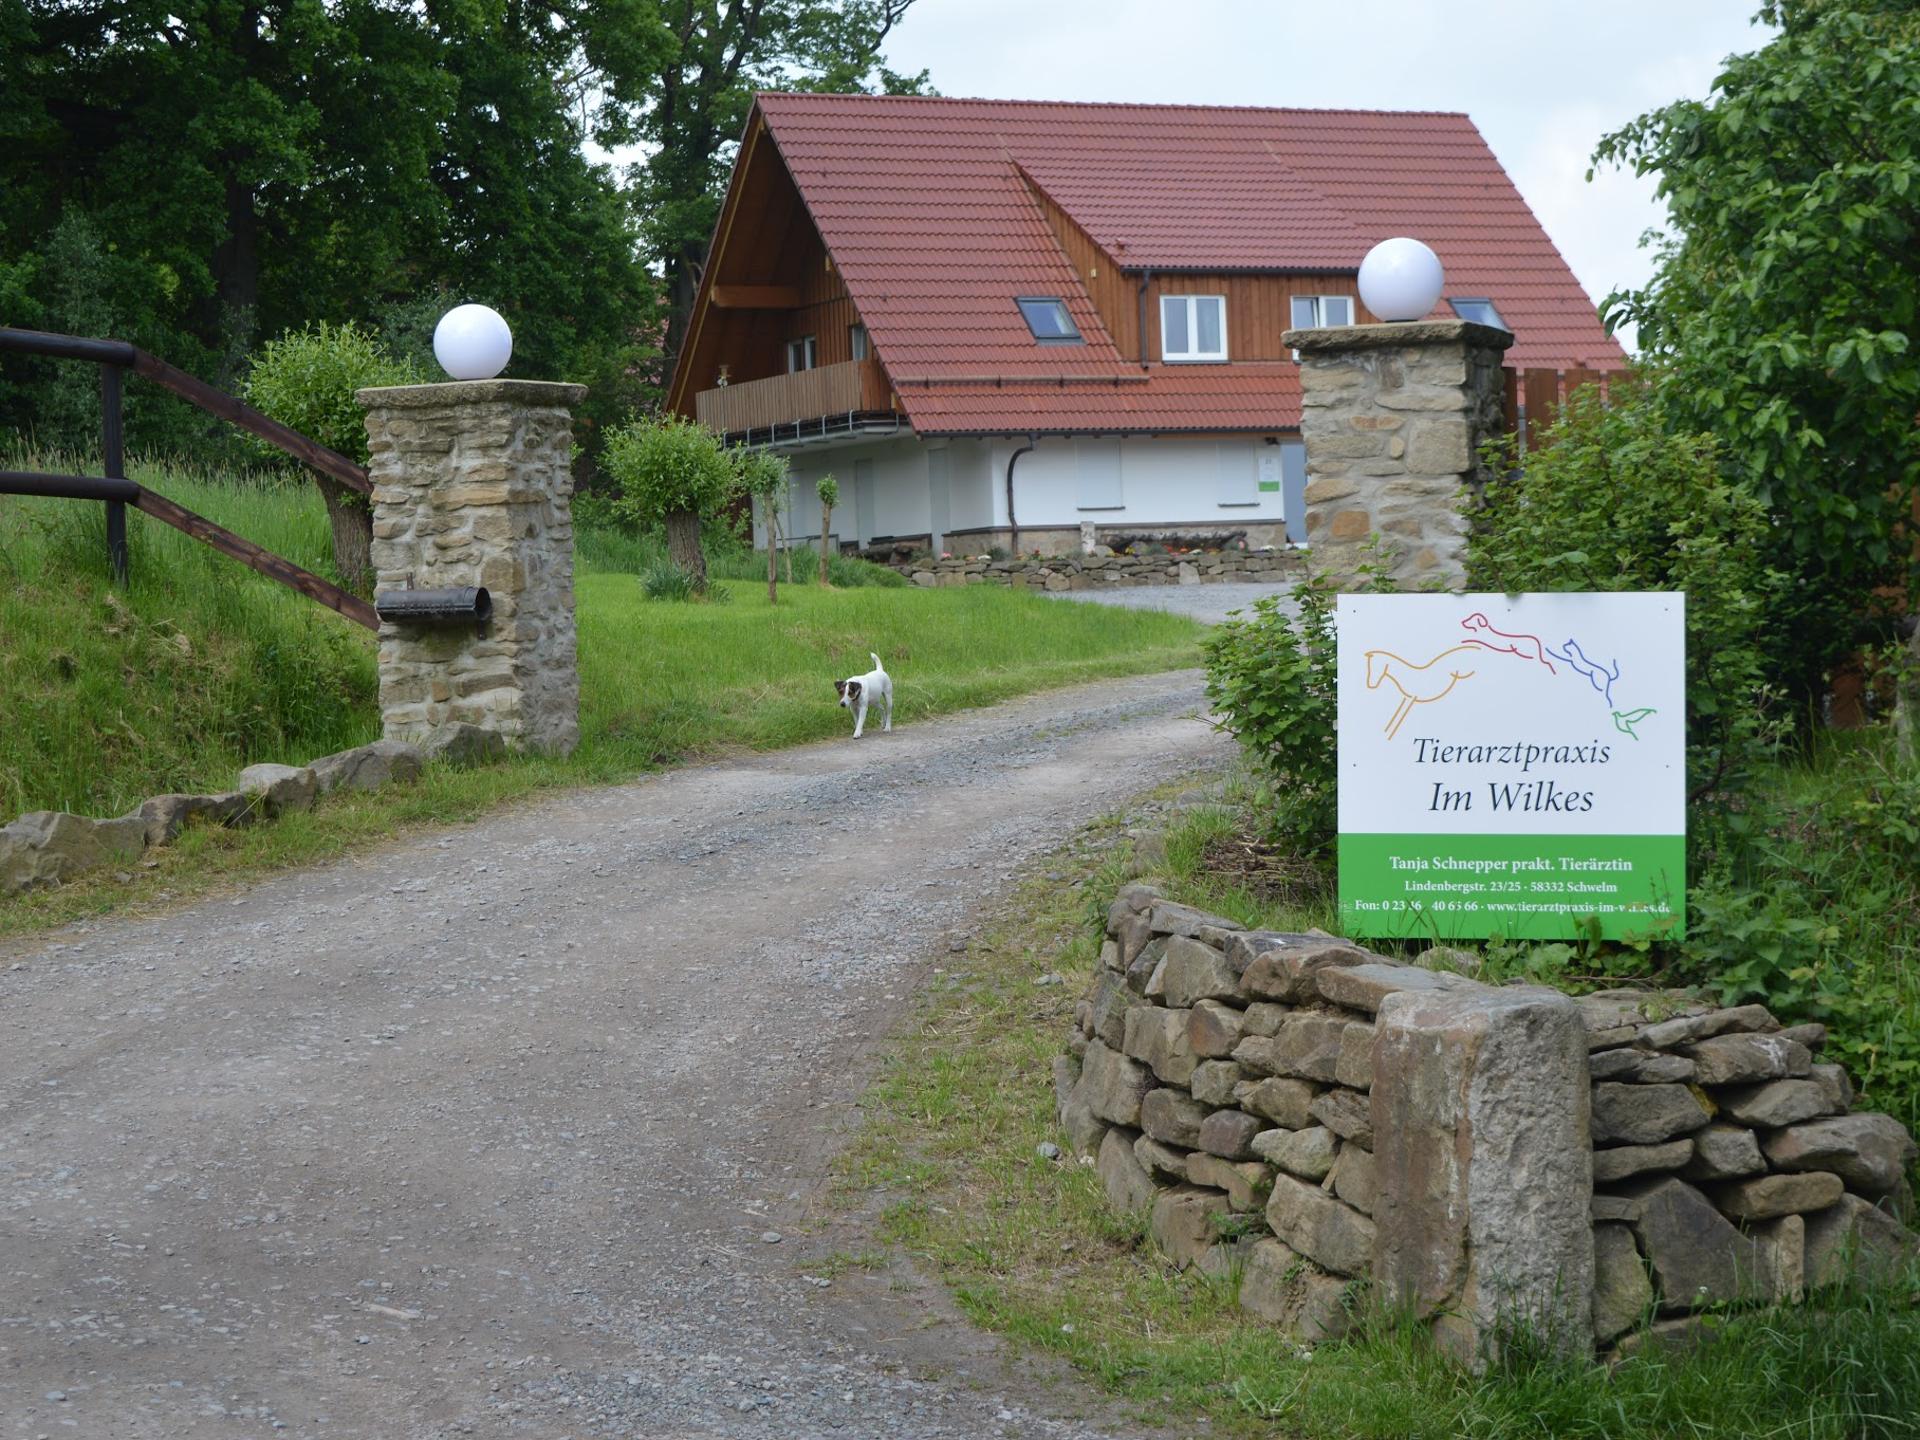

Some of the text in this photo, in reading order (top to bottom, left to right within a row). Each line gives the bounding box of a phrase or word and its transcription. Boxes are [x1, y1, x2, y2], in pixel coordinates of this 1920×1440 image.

[1413, 737, 1611, 773] Tierarztpraxis
[1428, 780, 1594, 812] Im Wilkes
[1389, 855, 1633, 874] Tanja Schnepper prakt. Tierärztin
[1405, 880, 1618, 894] Lindenbergstr. 23/25 58332 Schwelm
[1355, 899, 1380, 911] Fon:
[1382, 900, 1390, 911] 0
[1391, 900, 1406, 911] 23
[1431, 900, 1446, 911] 40
[1463, 901, 1479, 911] 66
